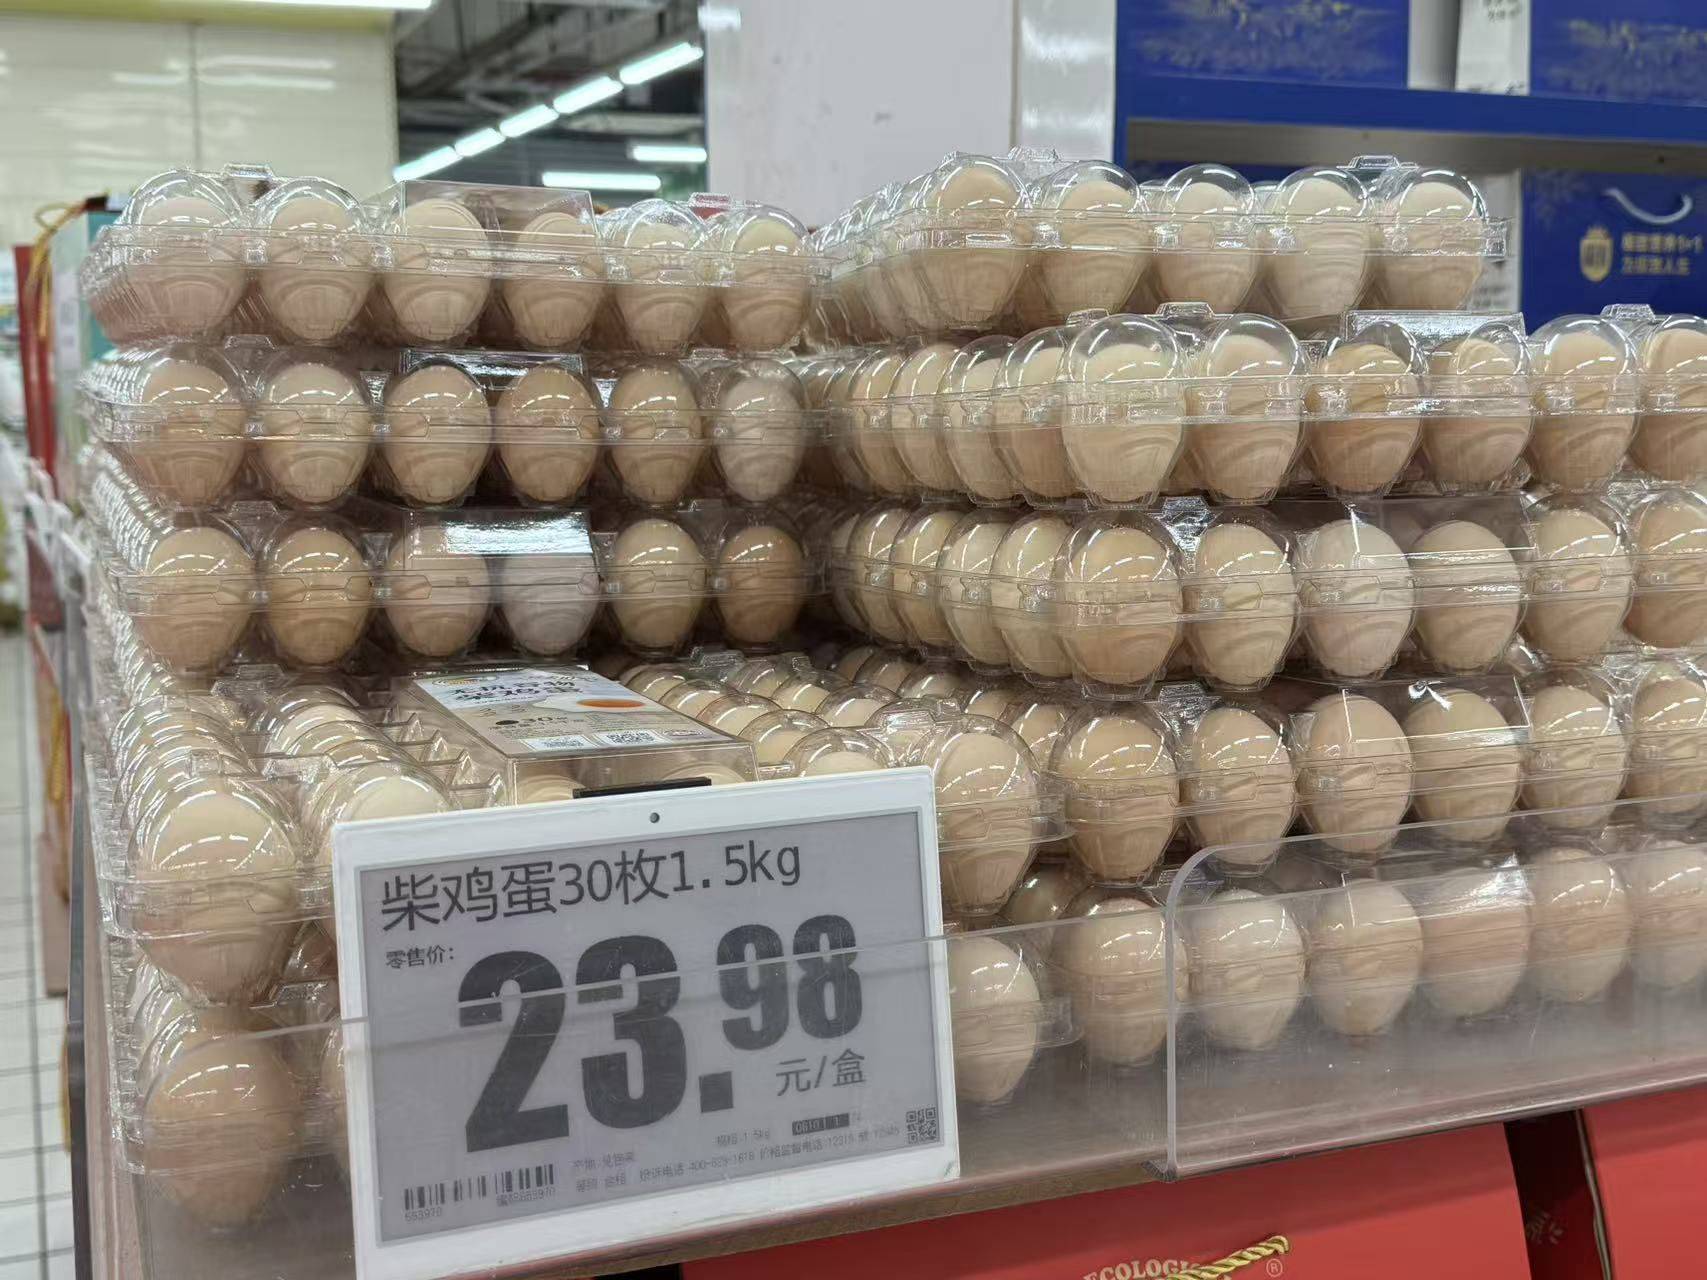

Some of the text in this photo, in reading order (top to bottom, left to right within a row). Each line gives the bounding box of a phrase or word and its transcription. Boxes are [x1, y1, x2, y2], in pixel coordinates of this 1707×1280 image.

[380, 839, 801, 932] 柴鸡蛋30枚1.5kg
[458, 913, 863, 1154] 23.98
[775, 1047, 867, 1097] 元/盒
